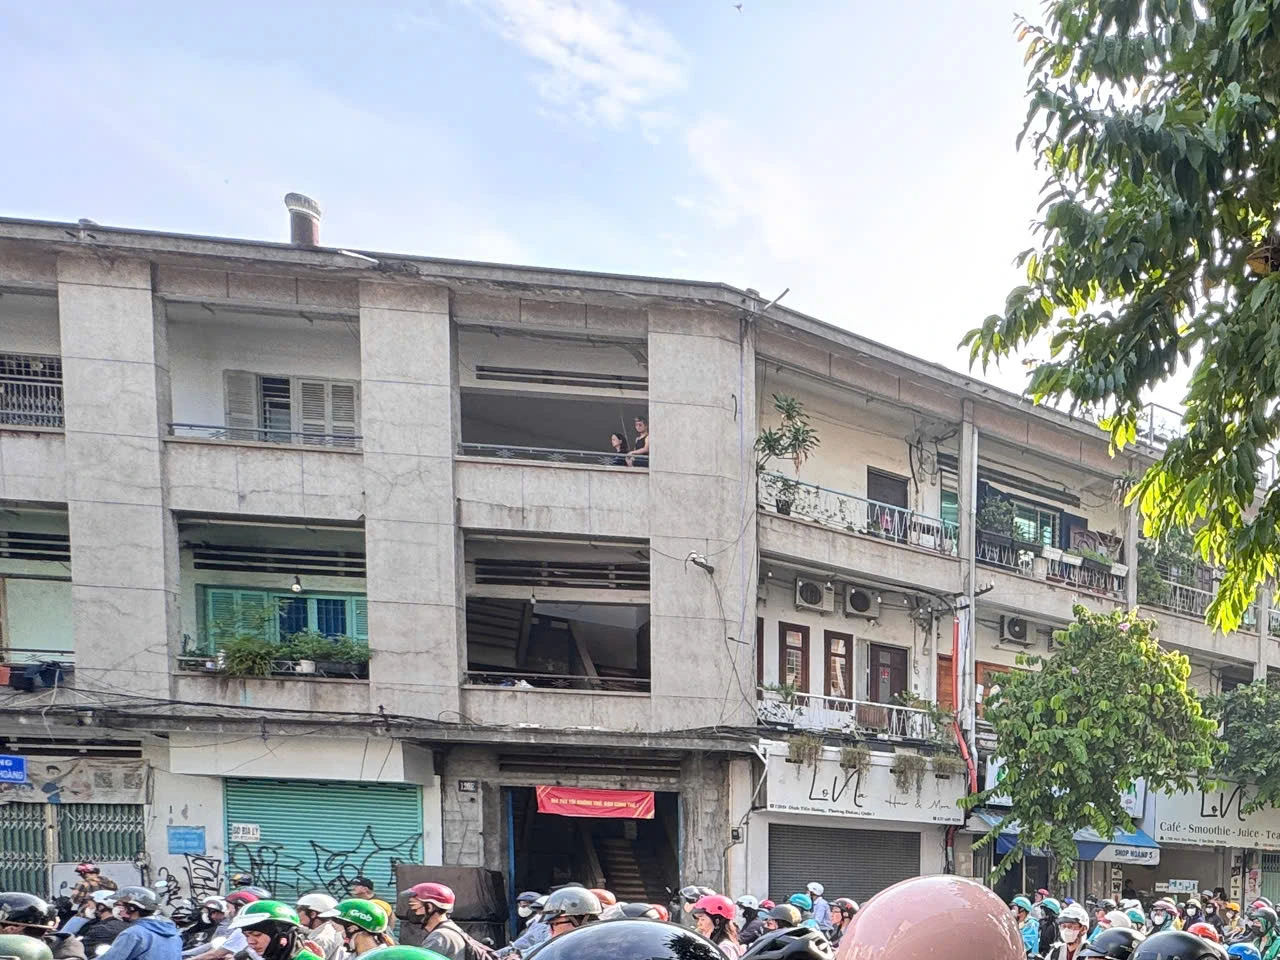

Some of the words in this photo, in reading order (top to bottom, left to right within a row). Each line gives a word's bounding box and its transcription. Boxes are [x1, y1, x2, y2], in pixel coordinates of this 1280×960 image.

[1160, 821, 1181, 833] Café
[1188, 823, 1231, 836] Smoothie
[1237, 828, 1259, 838] Juice
[1266, 830, 1280, 840] Tea
[1115, 849, 1129, 857] SHOP
[350, 909, 373, 921] Grab
